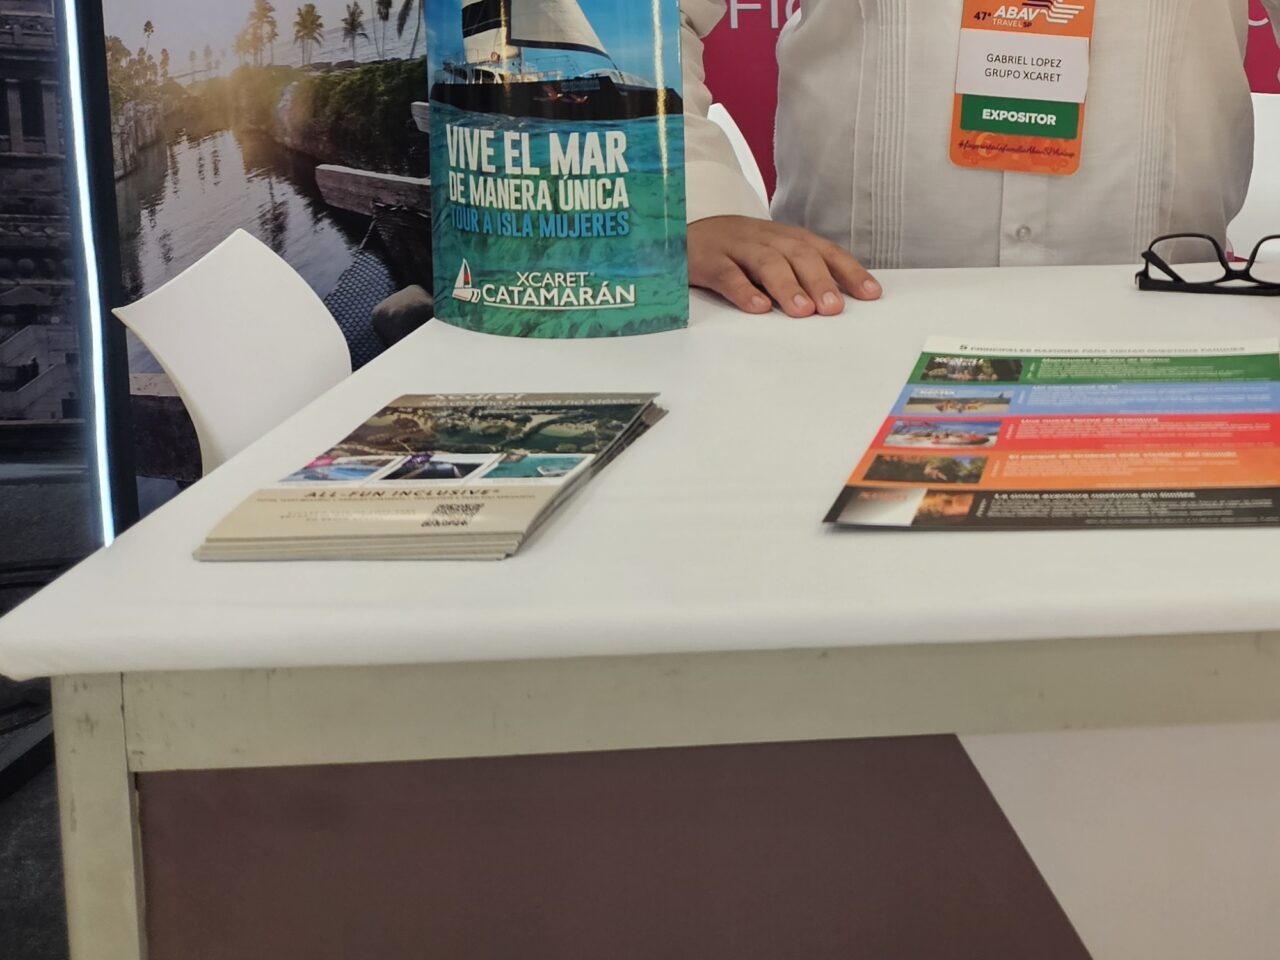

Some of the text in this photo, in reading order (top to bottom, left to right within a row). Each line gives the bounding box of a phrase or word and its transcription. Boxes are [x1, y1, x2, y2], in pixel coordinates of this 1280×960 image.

[993, 5, 1043, 22] ABAV
[986, 53, 1062, 69] GABRIEL LOPEZ
[984, 68, 1062, 83] GRUPO XCARET
[982, 108, 1057, 126] EXPOSITOR
[446, 123, 630, 176] VIVE EL MAR
[448, 170, 630, 212] DE MANERA ÚNICA
[450, 206, 630, 239] TOUR A ISLA MUJERES
[516, 271, 589, 288] XCARET
[482, 280, 636, 306] CATAMARÁN
